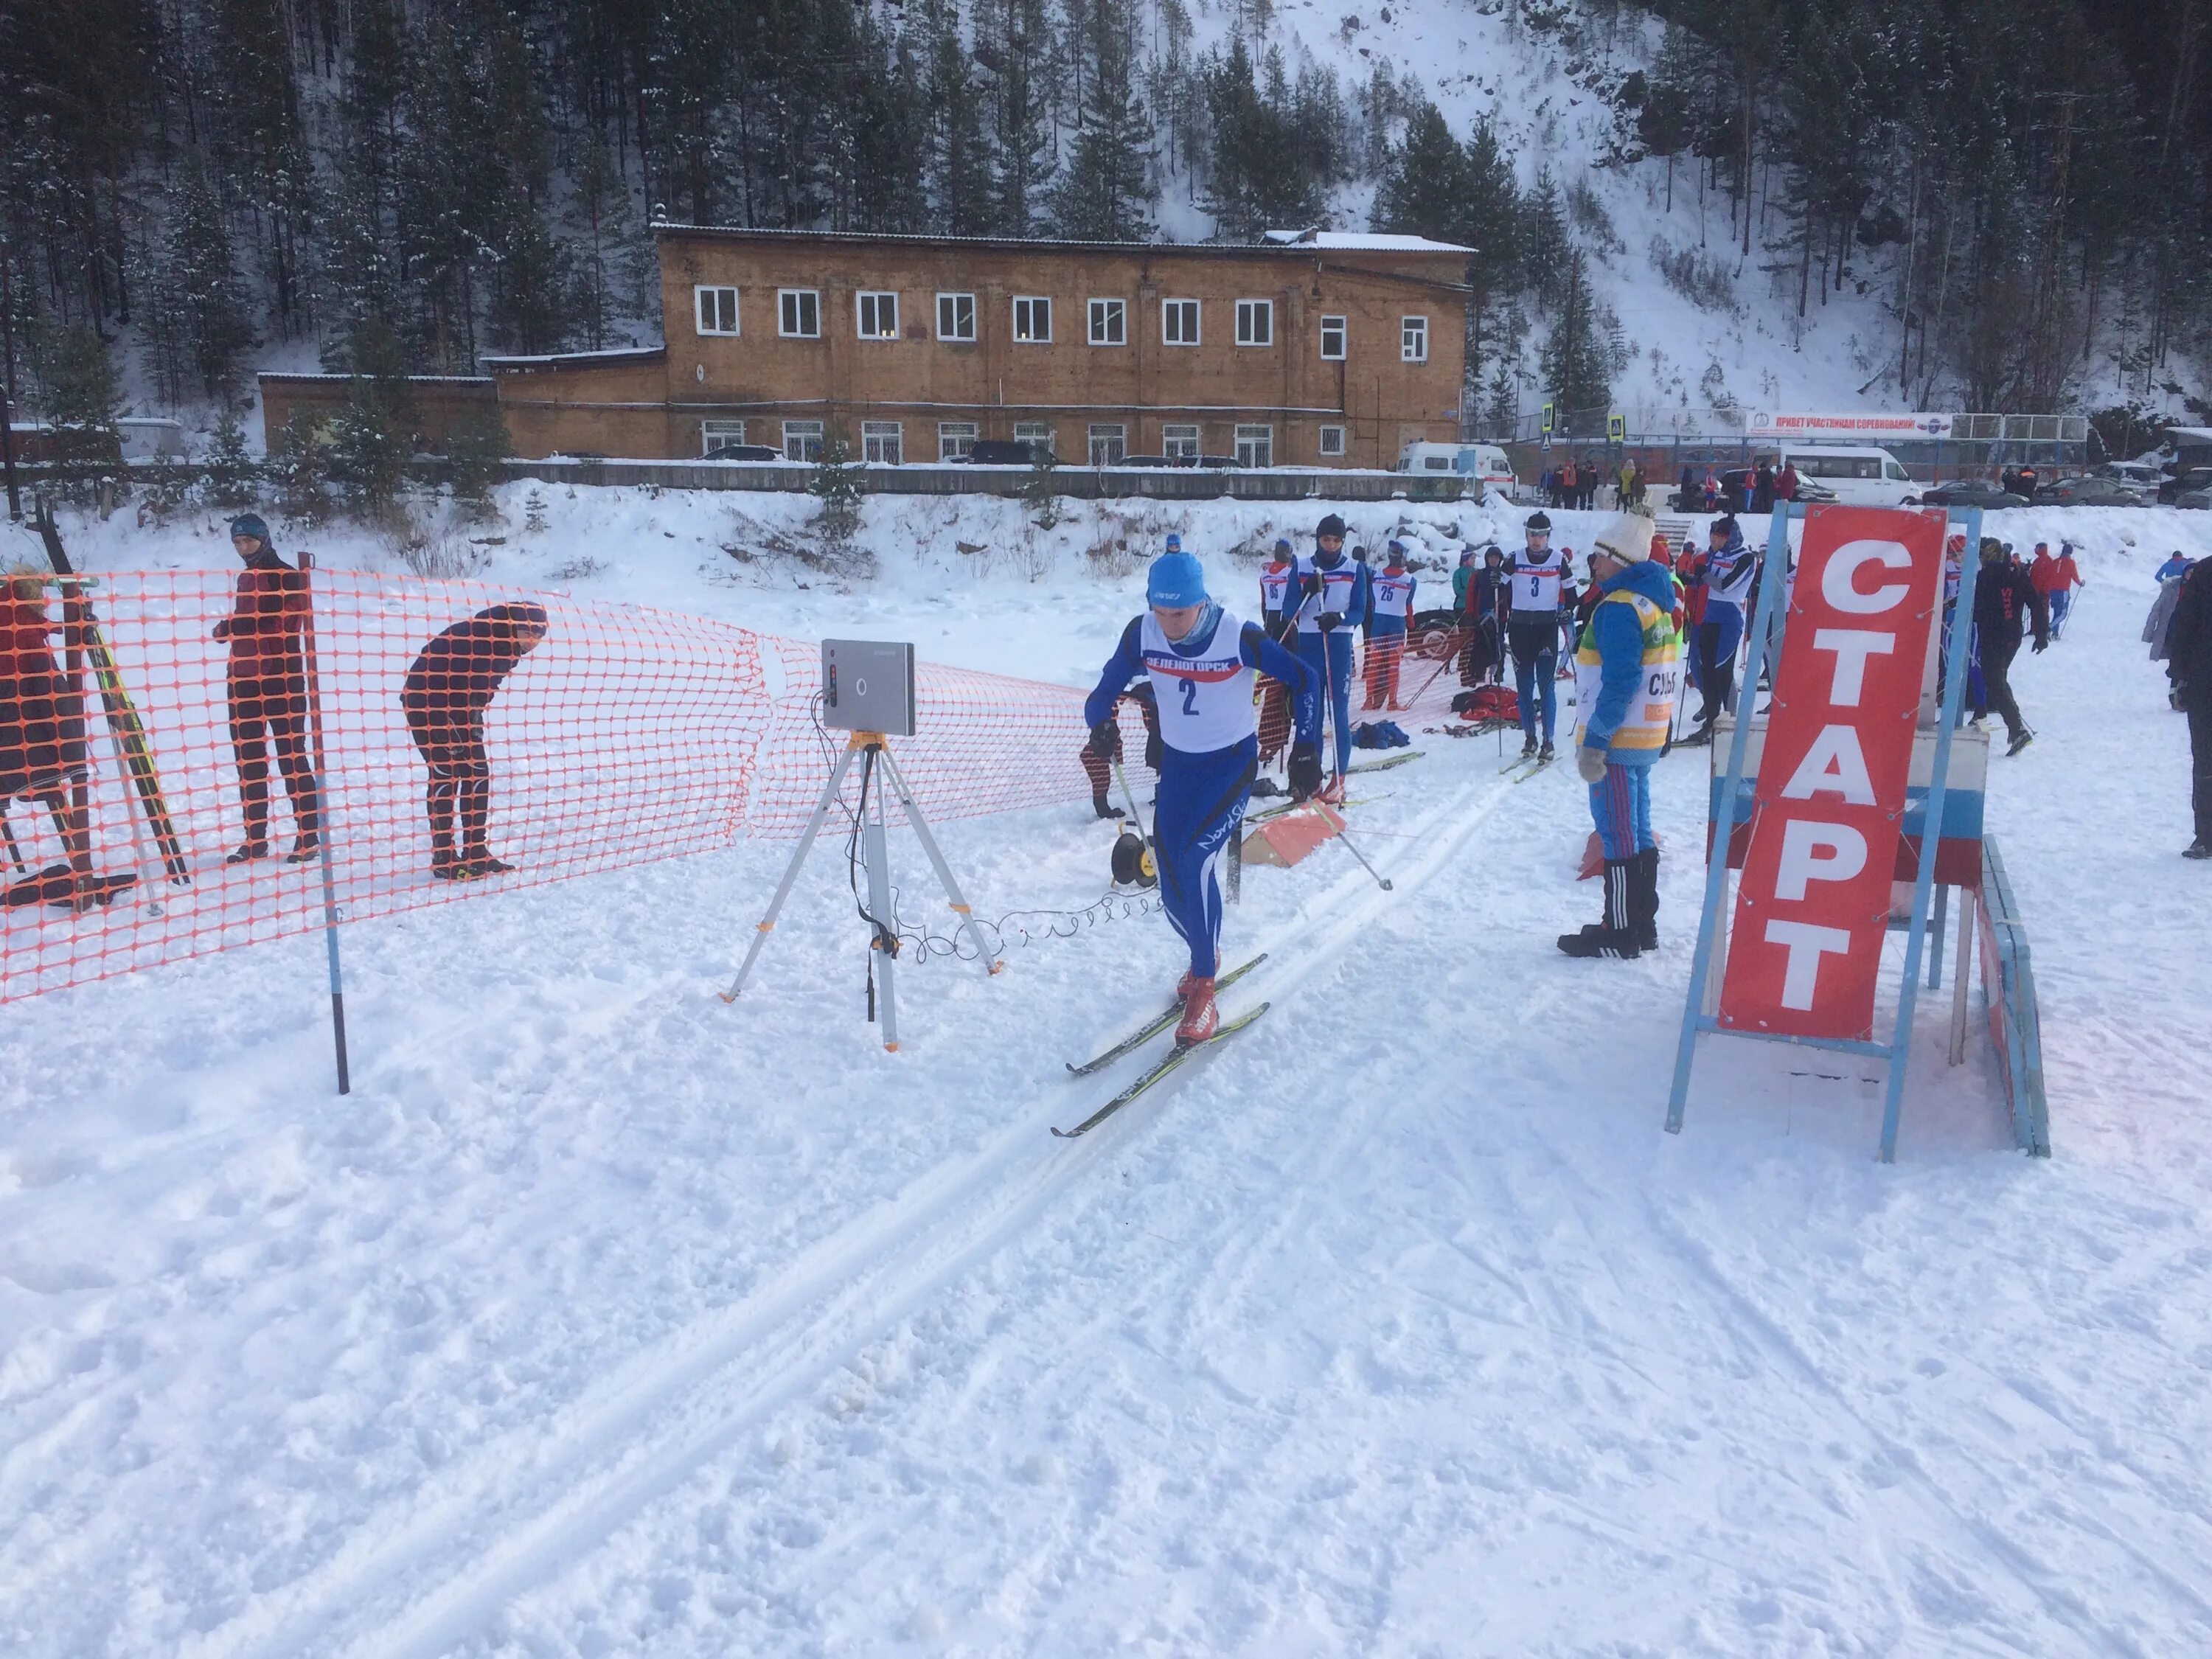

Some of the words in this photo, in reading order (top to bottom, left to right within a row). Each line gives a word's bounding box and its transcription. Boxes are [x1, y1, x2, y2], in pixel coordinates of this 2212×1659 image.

[1775, 417, 1805, 428] ПРИВЕТ
[1381, 585, 1394, 602] 25
[1531, 576, 1540, 597] 3
[1146, 656, 1231, 672] ЗЕЛЕНОГОРСК
[1178, 678, 1200, 716] 2
[1764, 539, 1911, 1012] СТАРТ
